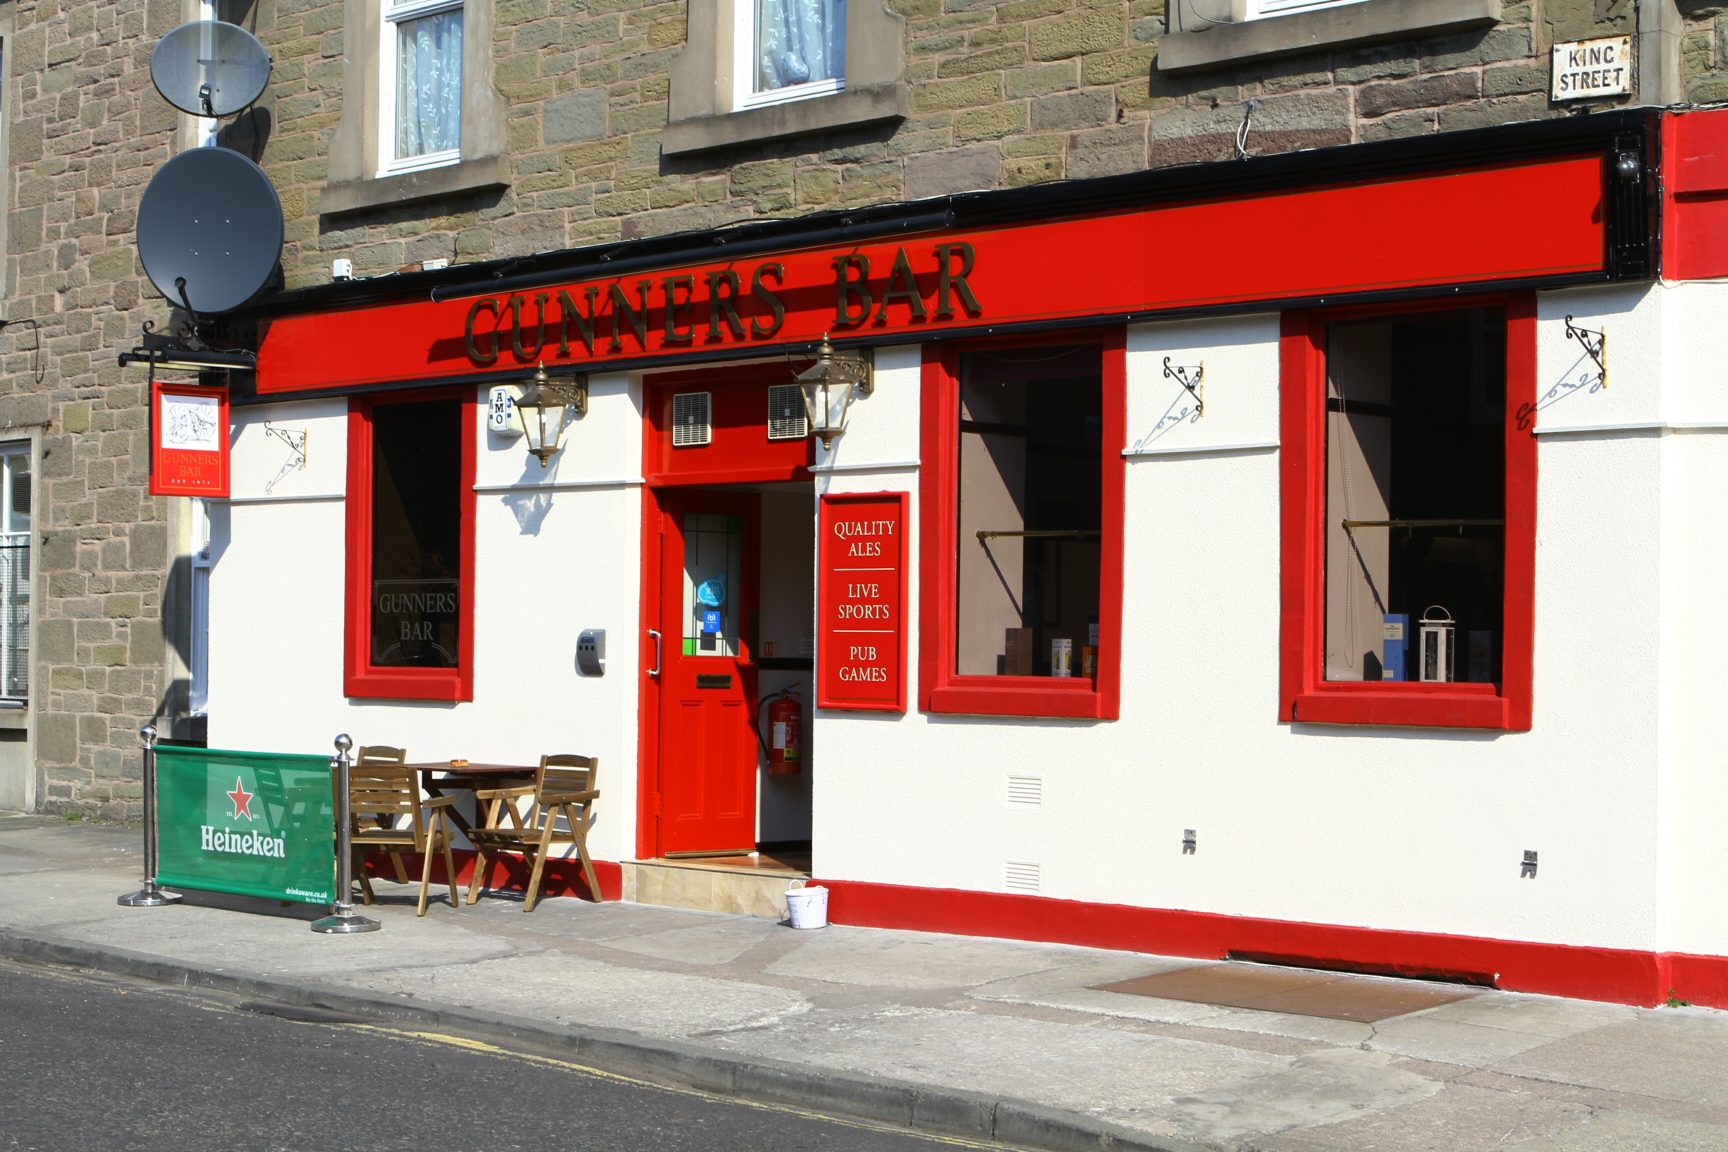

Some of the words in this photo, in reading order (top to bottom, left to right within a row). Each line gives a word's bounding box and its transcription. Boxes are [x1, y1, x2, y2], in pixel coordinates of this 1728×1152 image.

[1569, 45, 1614, 68] KING
[1560, 67, 1624, 92] STREET
[464, 262, 786, 363] GUNNERS
[831, 241, 983, 326] BAR
[162, 453, 218, 465] GUNNERS
[180, 465, 202, 477] BAR
[834, 521, 895, 539] QUALITY
[848, 541, 881, 557] ALES
[848, 583, 879, 598] LIVE
[379, 592, 456, 614] GUNNERS
[838, 604, 890, 619] SPORTS
[400, 621, 434, 641] BAR
[850, 646, 877, 661] PUB
[839, 666, 887, 682] GAMES
[201, 825, 285, 858] Heineken
